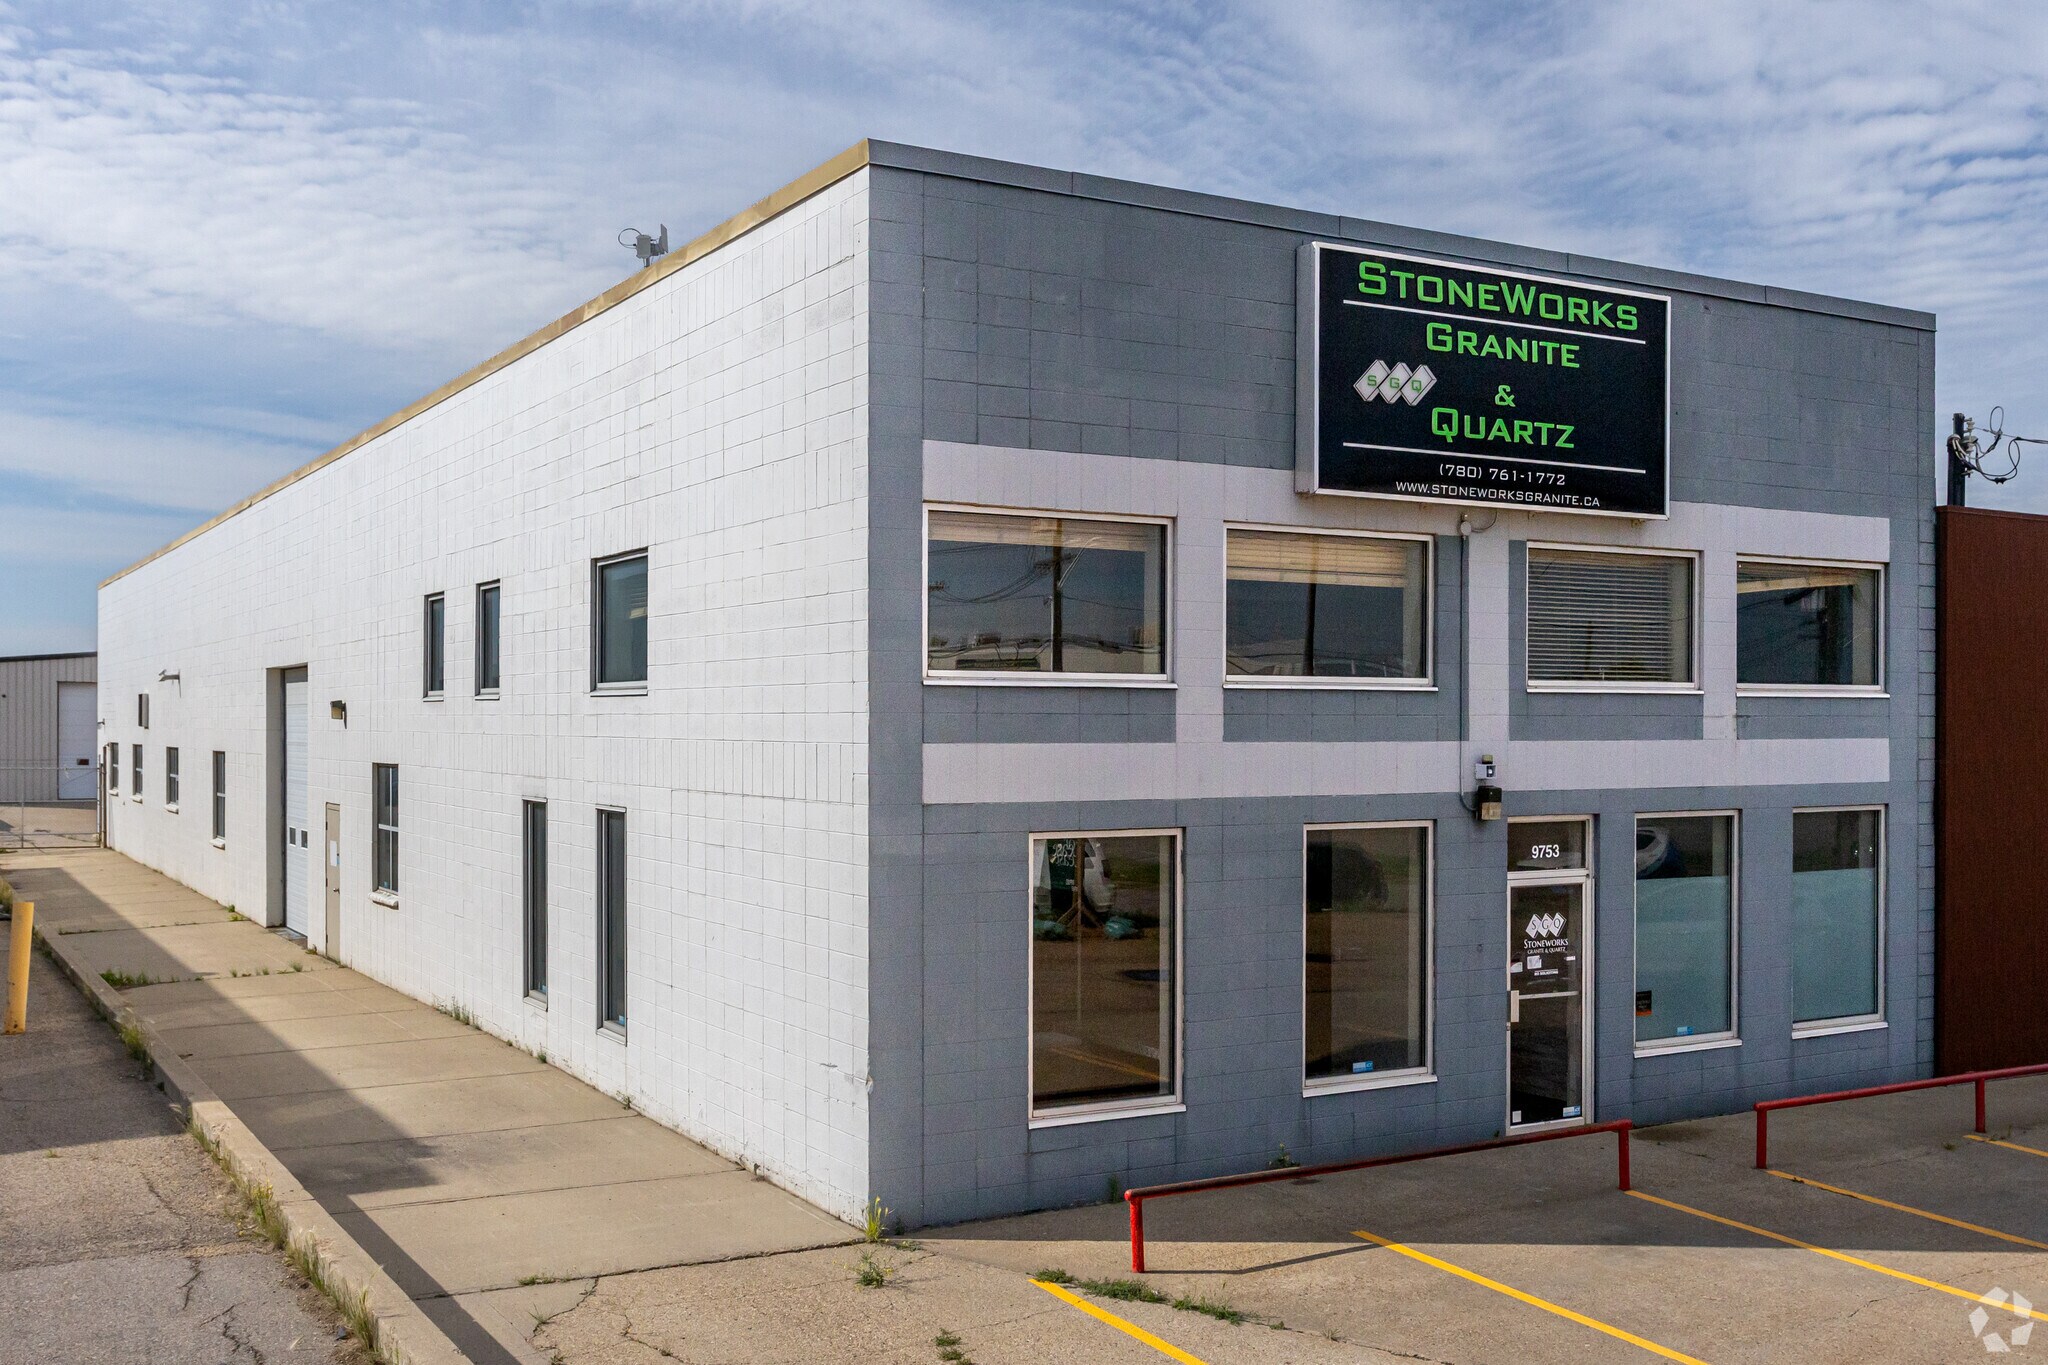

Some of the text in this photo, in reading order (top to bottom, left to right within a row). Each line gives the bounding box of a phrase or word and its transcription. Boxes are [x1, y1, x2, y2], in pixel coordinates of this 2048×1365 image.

[1358, 261, 1638, 331] STONEWORKS
[1426, 321, 1581, 368] GRANITE
[1494, 384, 1516, 407] &
[1431, 406, 1575, 449] QUARTZ
[1439, 463, 1566, 486] (780) 761-1772
[1396, 481, 1601, 507] WWW.STONEWORKSGRANITE.CA
[1531, 844, 1560, 859] 9753
[1523, 938, 1569, 949] STONEWORKS
